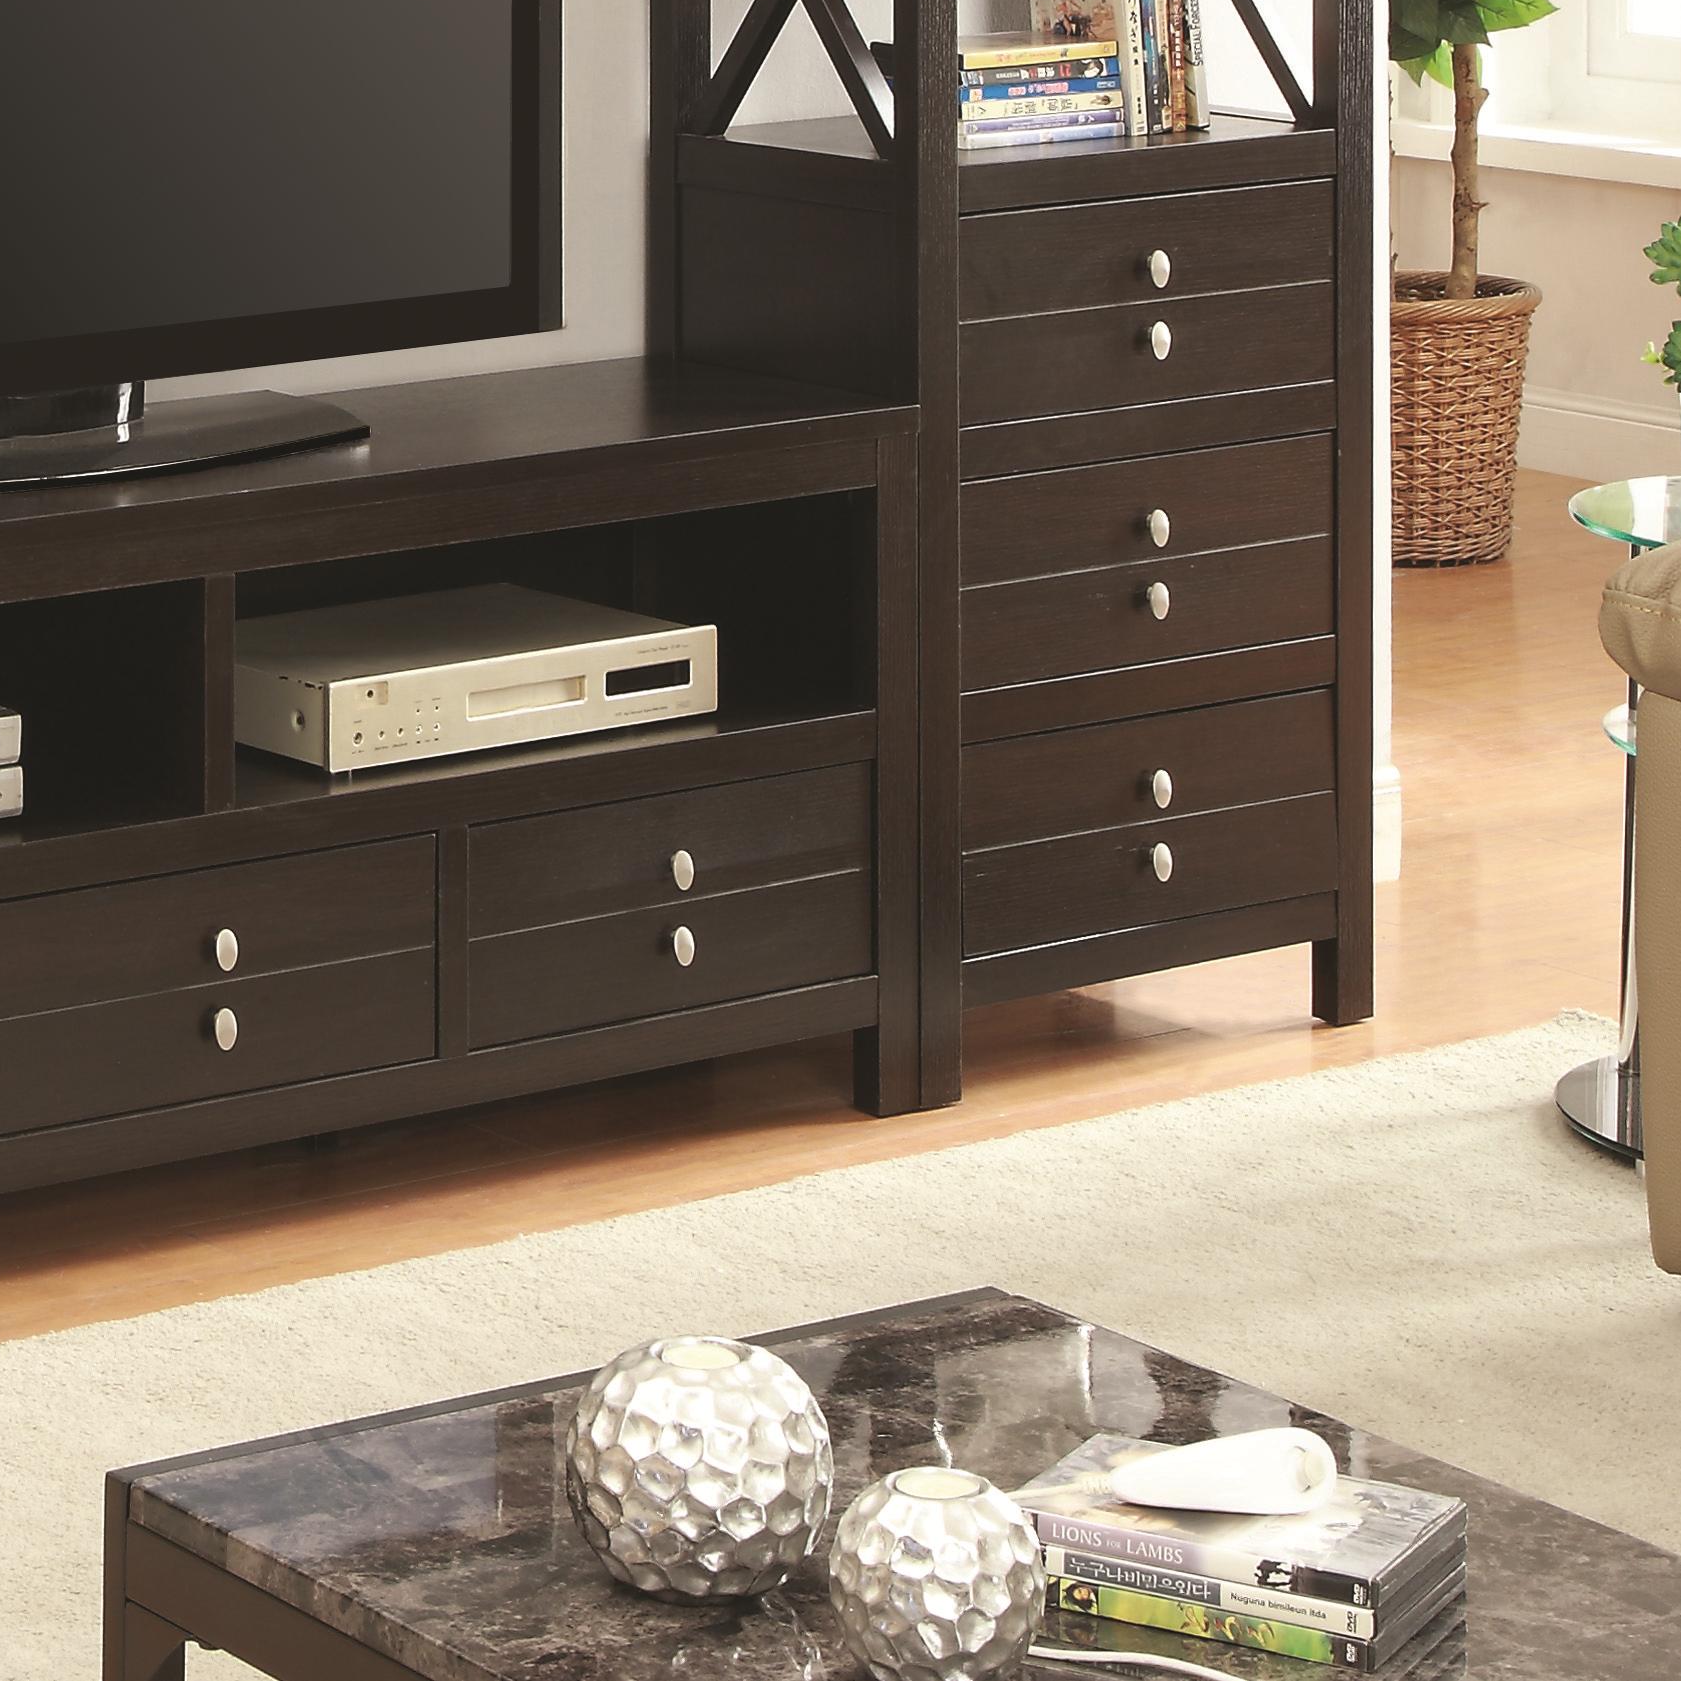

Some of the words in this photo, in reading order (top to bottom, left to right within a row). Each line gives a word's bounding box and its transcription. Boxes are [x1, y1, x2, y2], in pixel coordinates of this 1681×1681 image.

[1192, 31, 1203, 67] SPECIAL
[1052, 1523, 1102, 1546] LIONS
[1127, 1539, 1184, 1564] LAMBS
[1231, 1592, 1265, 1606] Nuguna
